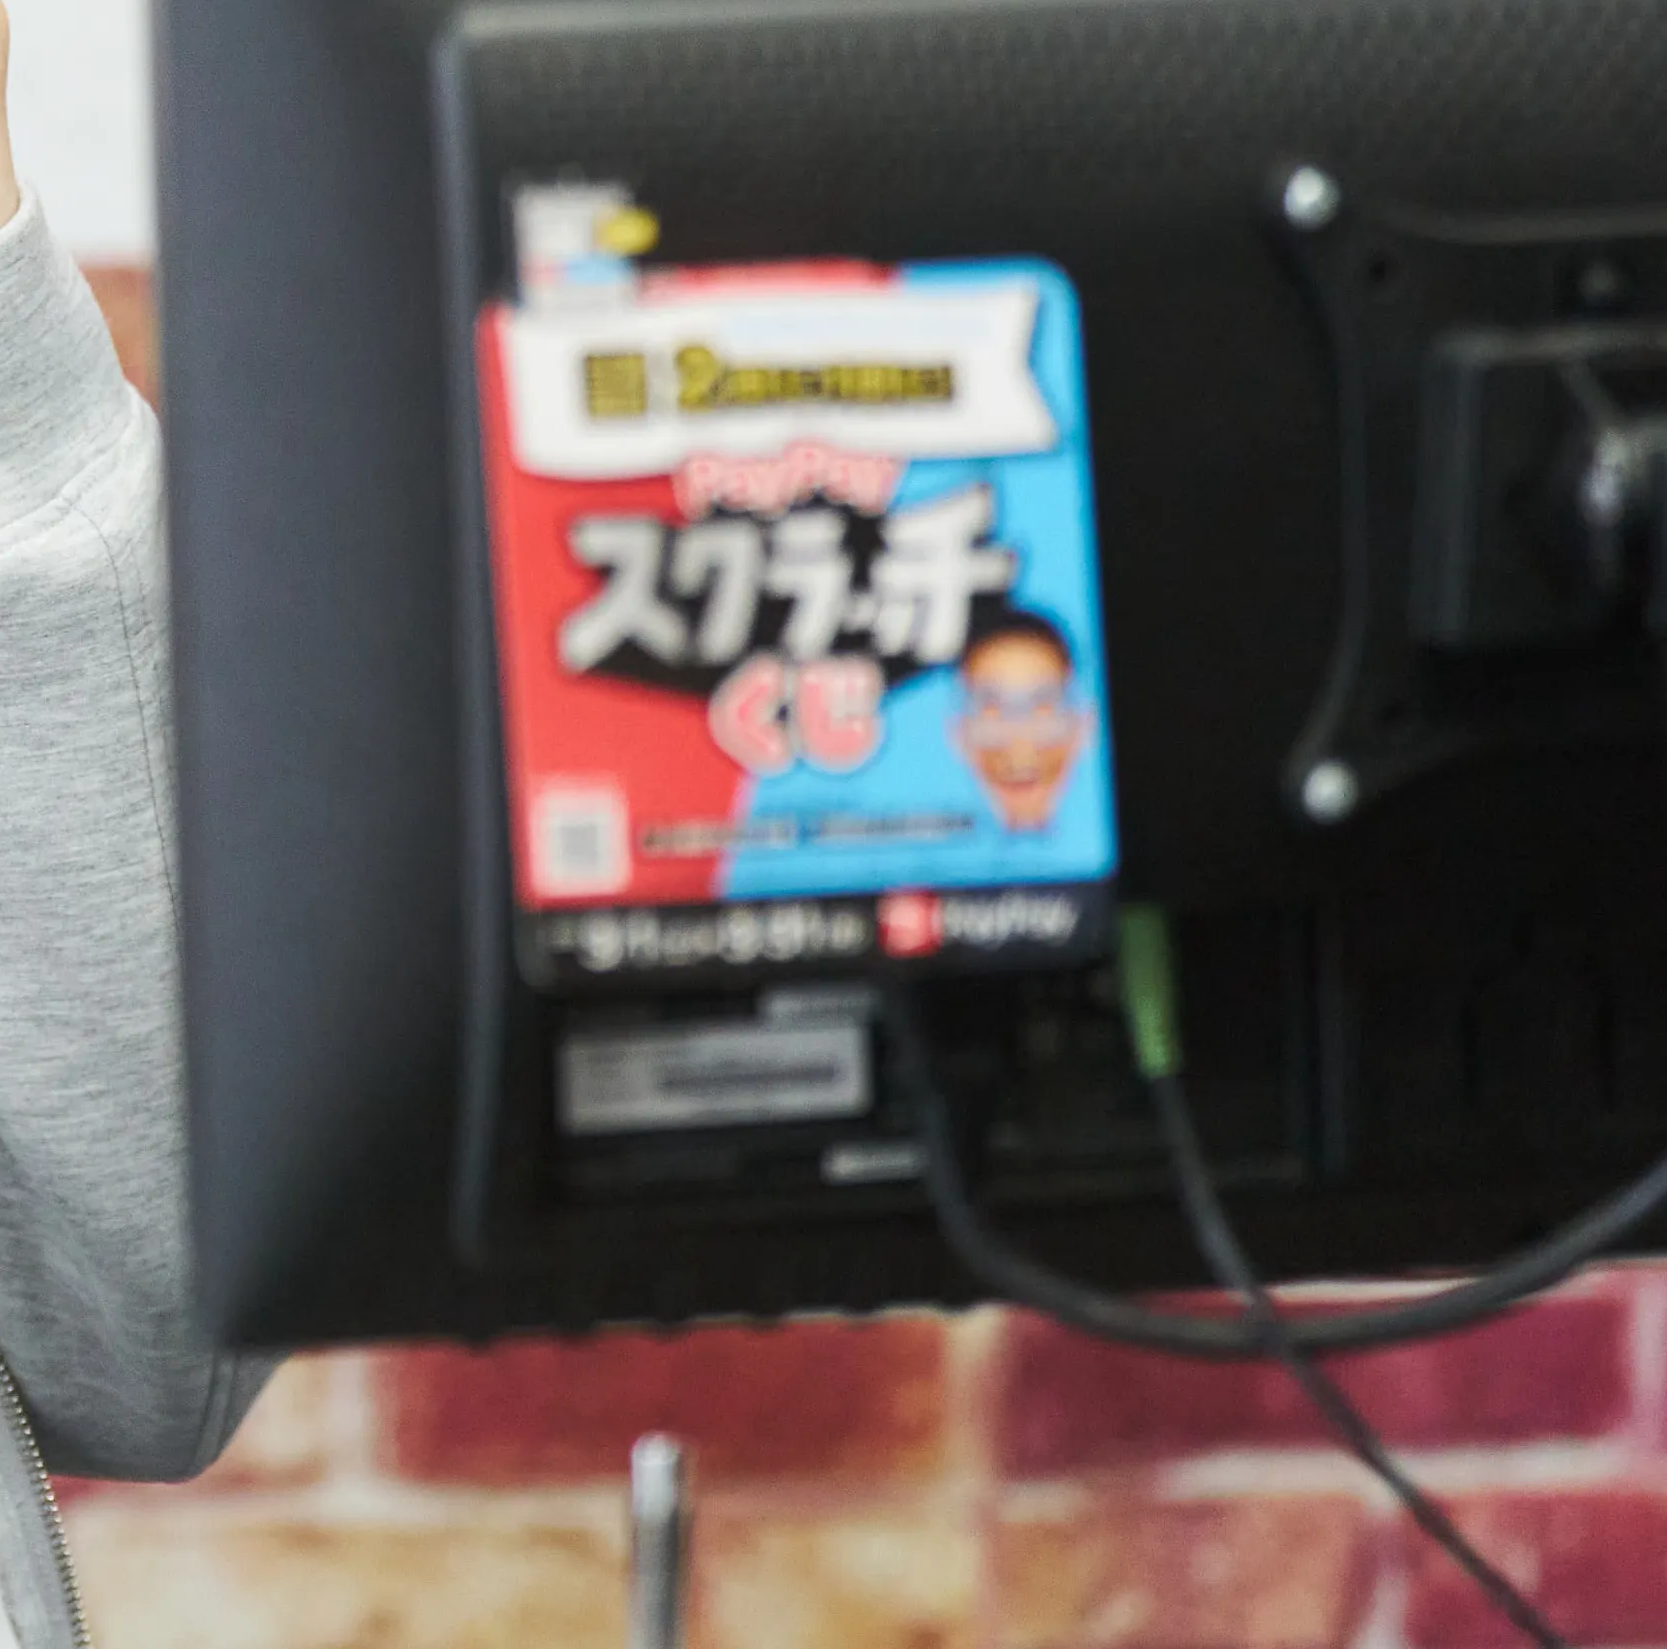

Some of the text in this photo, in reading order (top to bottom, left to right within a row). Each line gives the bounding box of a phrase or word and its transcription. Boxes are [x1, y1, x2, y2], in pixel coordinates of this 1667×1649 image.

[560, 484, 1014, 672] スクラッチ
[713, 656, 882, 773] くじ
